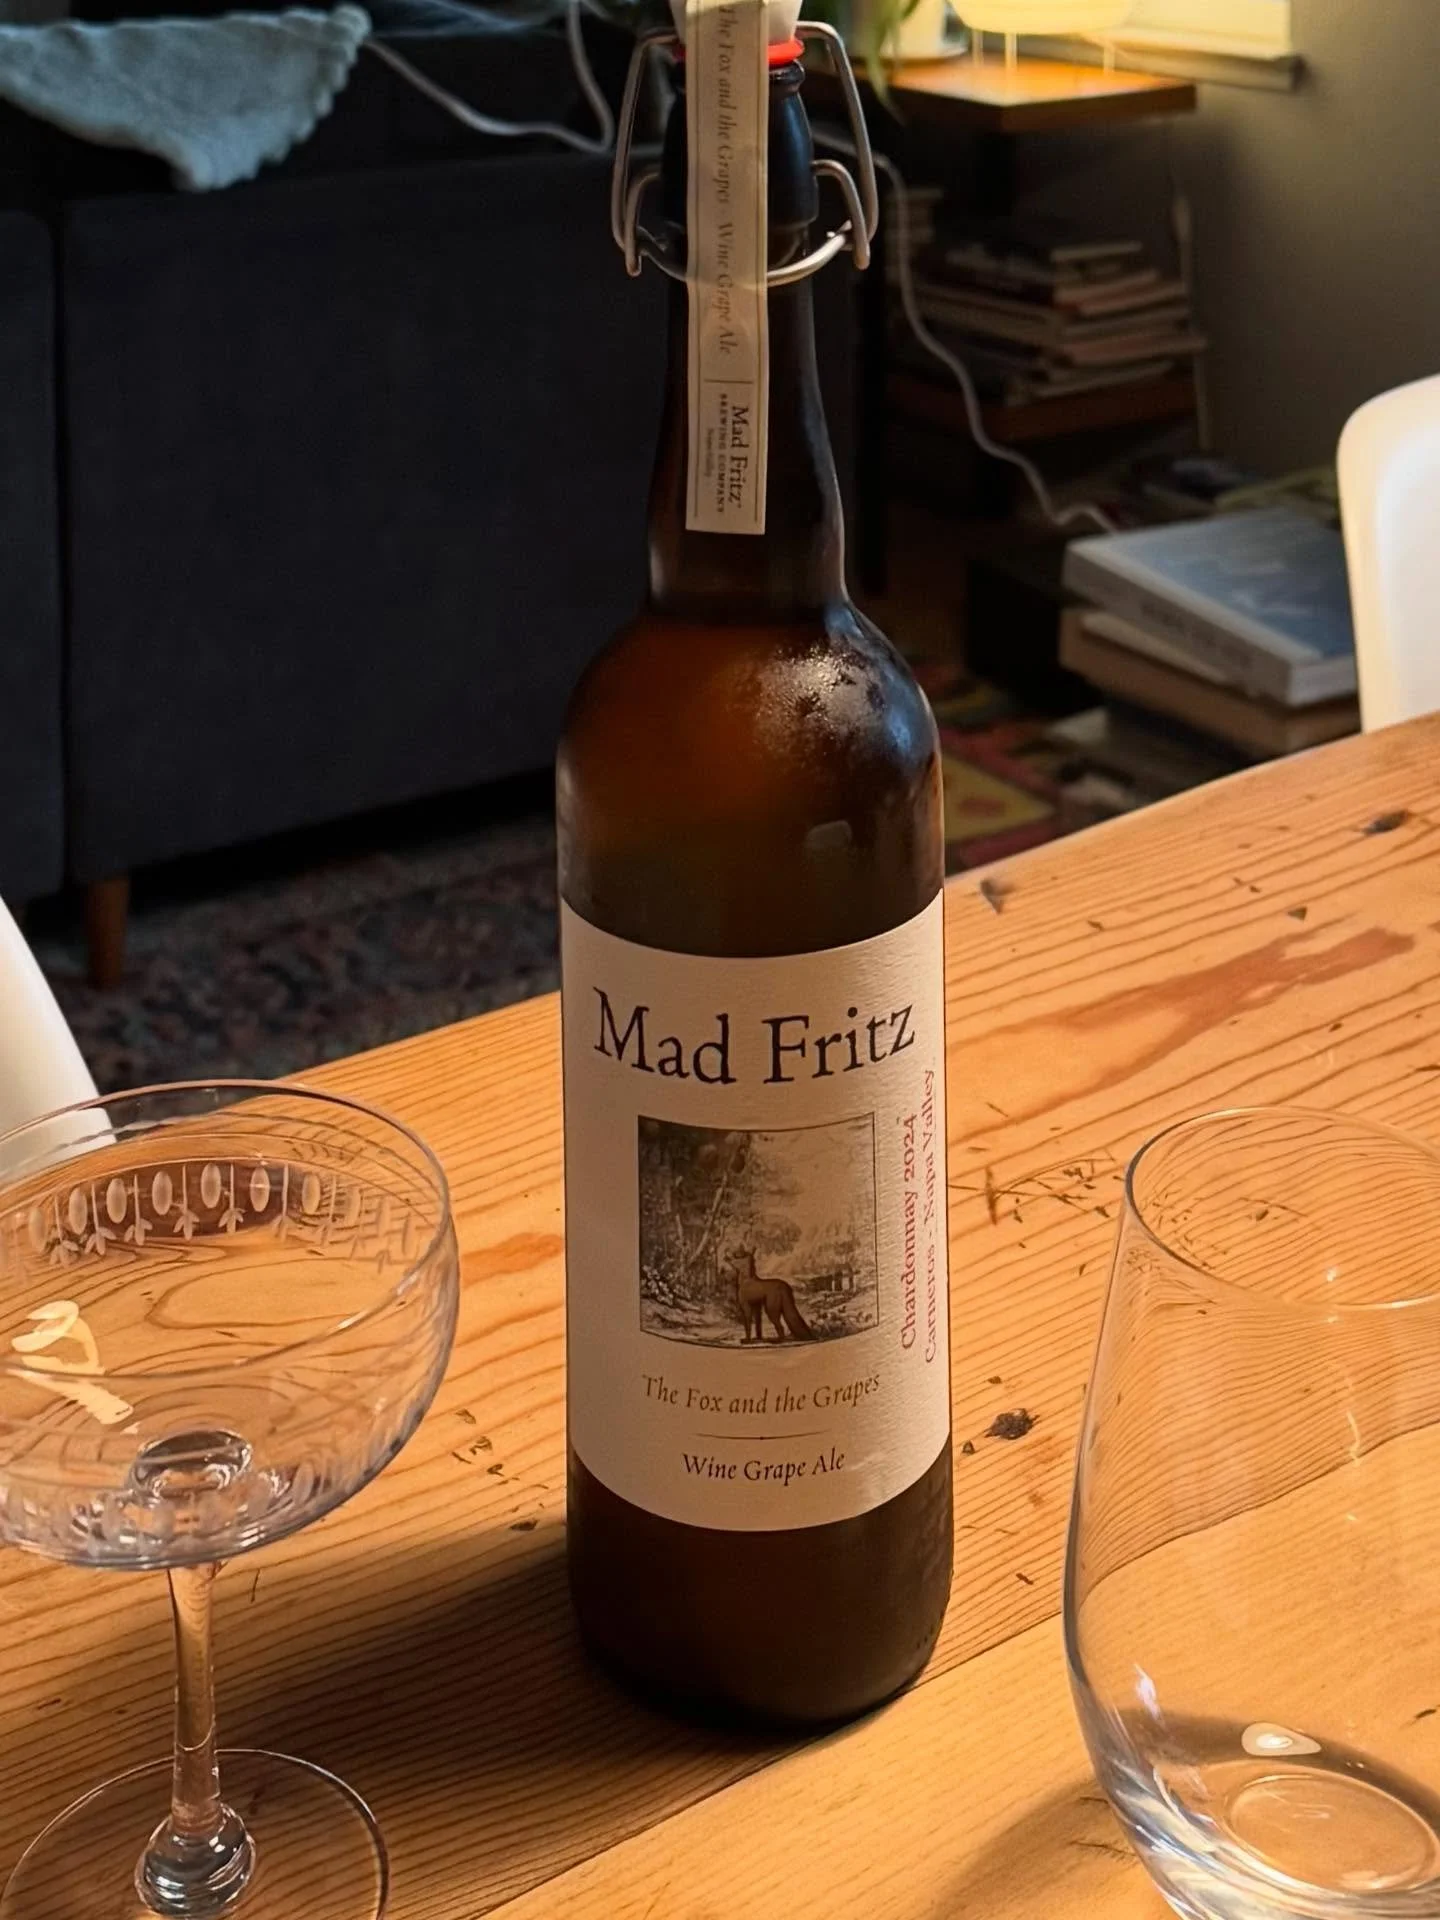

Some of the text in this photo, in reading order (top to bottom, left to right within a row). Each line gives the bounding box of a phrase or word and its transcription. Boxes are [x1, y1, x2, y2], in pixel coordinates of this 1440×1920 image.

[718, 44, 736, 72] Fox
[717, 78, 738, 110] and
[716, 115, 738, 137] the
[711, 144, 735, 204] Grapes
[716, 221, 735, 269] Wine
[711, 274, 735, 322] Grape
[718, 327, 739, 355] Ale
[730, 405, 750, 449] Mad
[715, 393, 729, 513] BREWING COMPANY
[593, 986, 916, 1085] Mad Fritz
[921, 1069, 935, 1152] Valley
[923, 1152, 936, 1225] Napa
[900, 1113, 919, 1349] Chardonnay 2024
[925, 1244, 937, 1364] Carneros
[642, 1373, 880, 1414] The Fox and the Grapes
[682, 1447, 846, 1487] Wine Grape Ale
